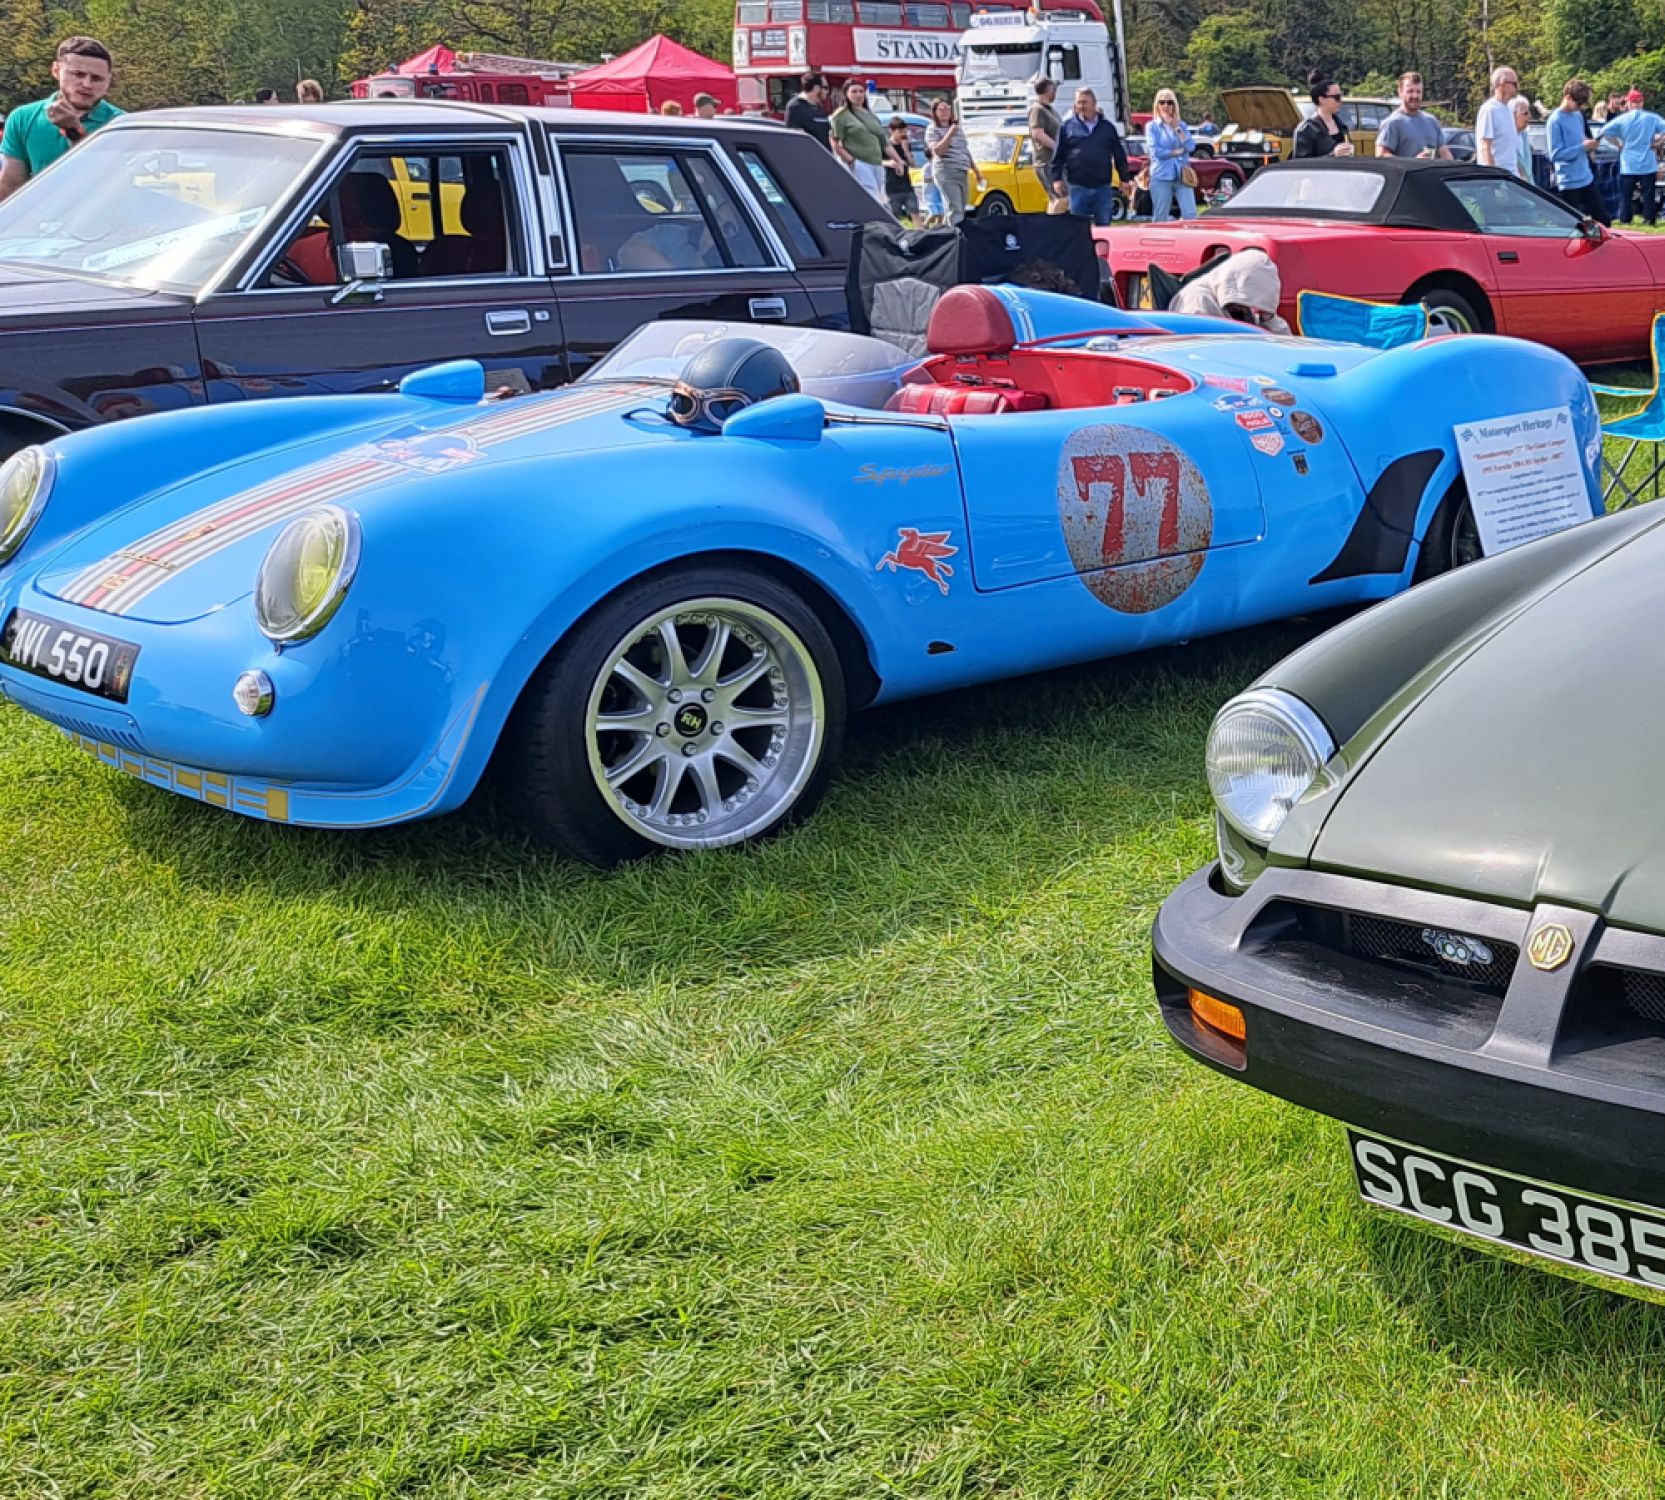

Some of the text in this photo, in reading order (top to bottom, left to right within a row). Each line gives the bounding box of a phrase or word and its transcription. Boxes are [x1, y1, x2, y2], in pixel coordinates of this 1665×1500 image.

[877, 40, 961, 60] STANDA
[1479, 418, 1553, 439] Motorsport Heritage
[852, 464, 954, 487] Spyder
[1071, 453, 1180, 577] 77
[47, 631, 109, 689] 550
[1533, 930, 1565, 963] MG
[1356, 1139, 1503, 1237] SCG
